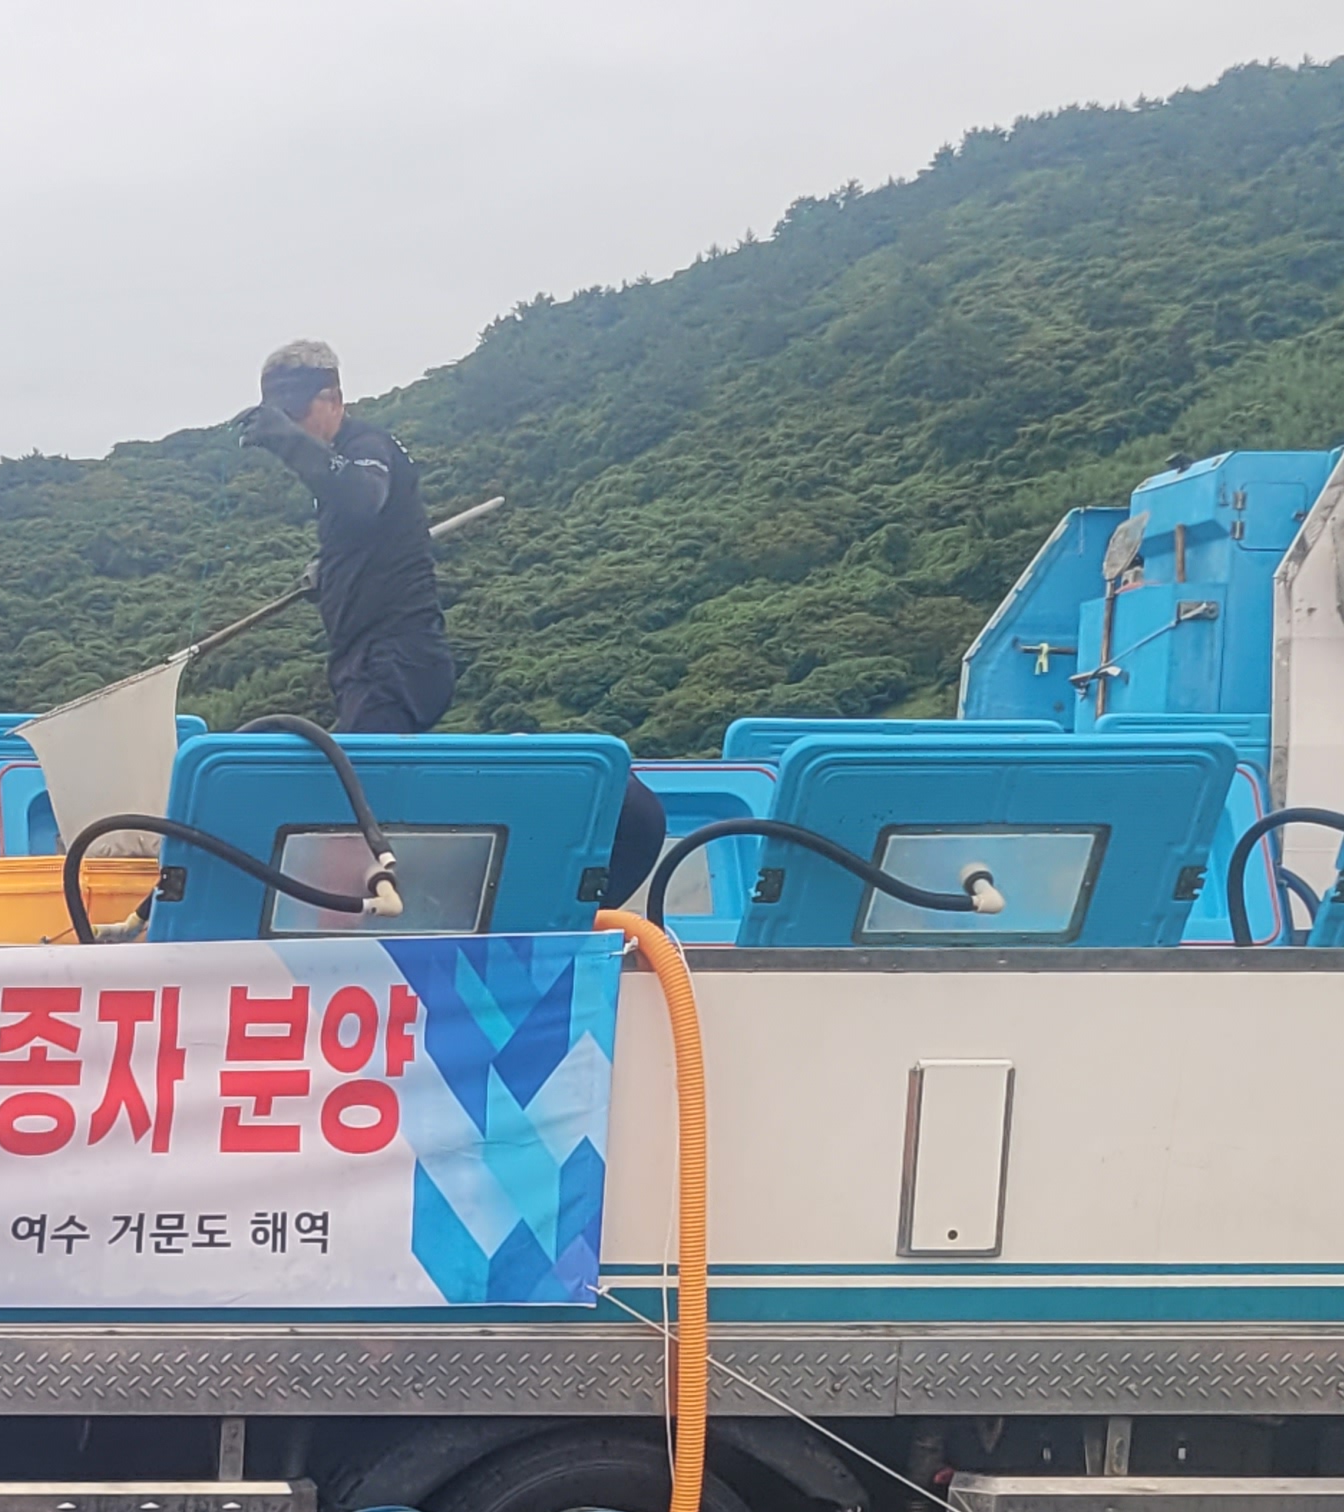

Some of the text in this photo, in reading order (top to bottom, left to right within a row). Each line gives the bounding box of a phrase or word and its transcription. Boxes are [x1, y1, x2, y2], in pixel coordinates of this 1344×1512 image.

[219, 986, 418, 1154] 분양
[11, 1214, 90, 1255] 여수
[107, 1212, 232, 1254] 거문도
[250, 1211, 330, 1254] 해역
